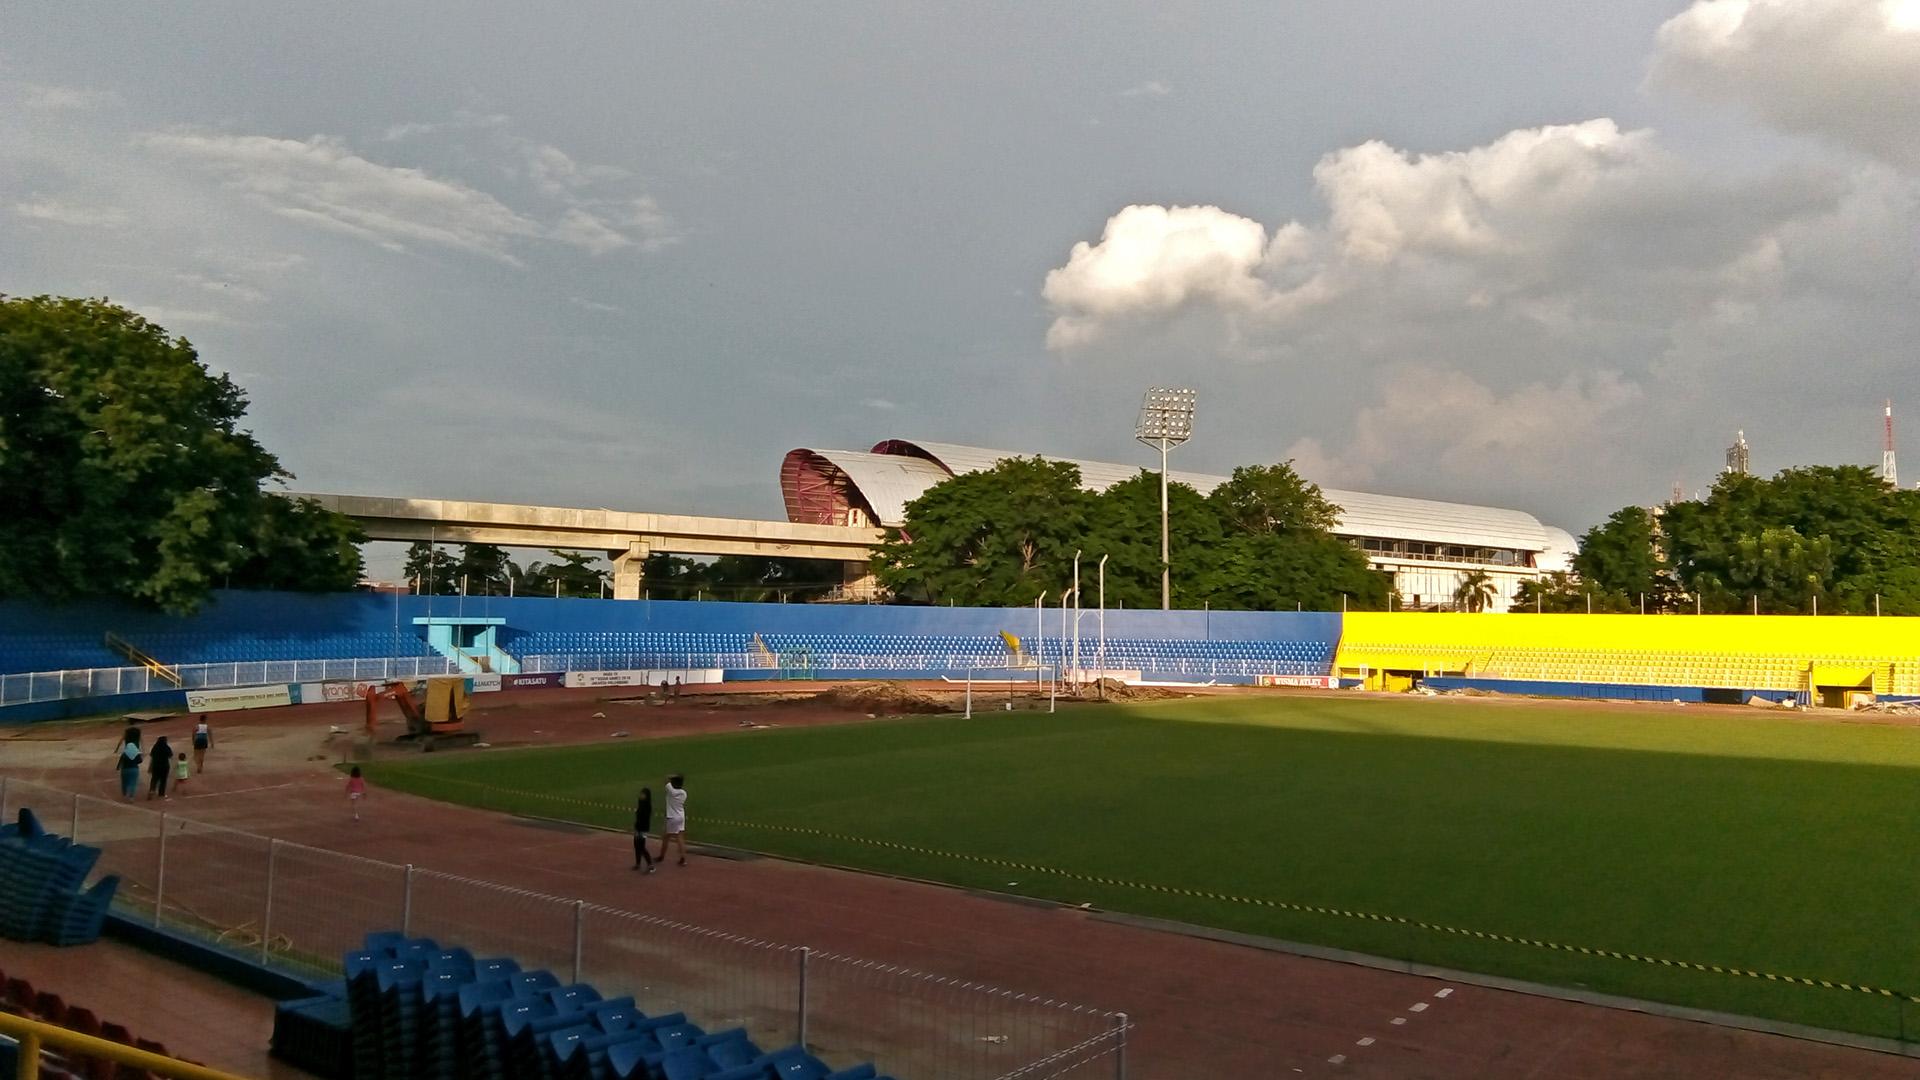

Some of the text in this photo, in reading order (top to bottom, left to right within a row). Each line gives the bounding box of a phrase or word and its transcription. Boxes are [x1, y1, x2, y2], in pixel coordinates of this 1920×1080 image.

[513, 677, 547, 686] #KITASATU
[1274, 677, 1322, 686] WISMA ATLET
